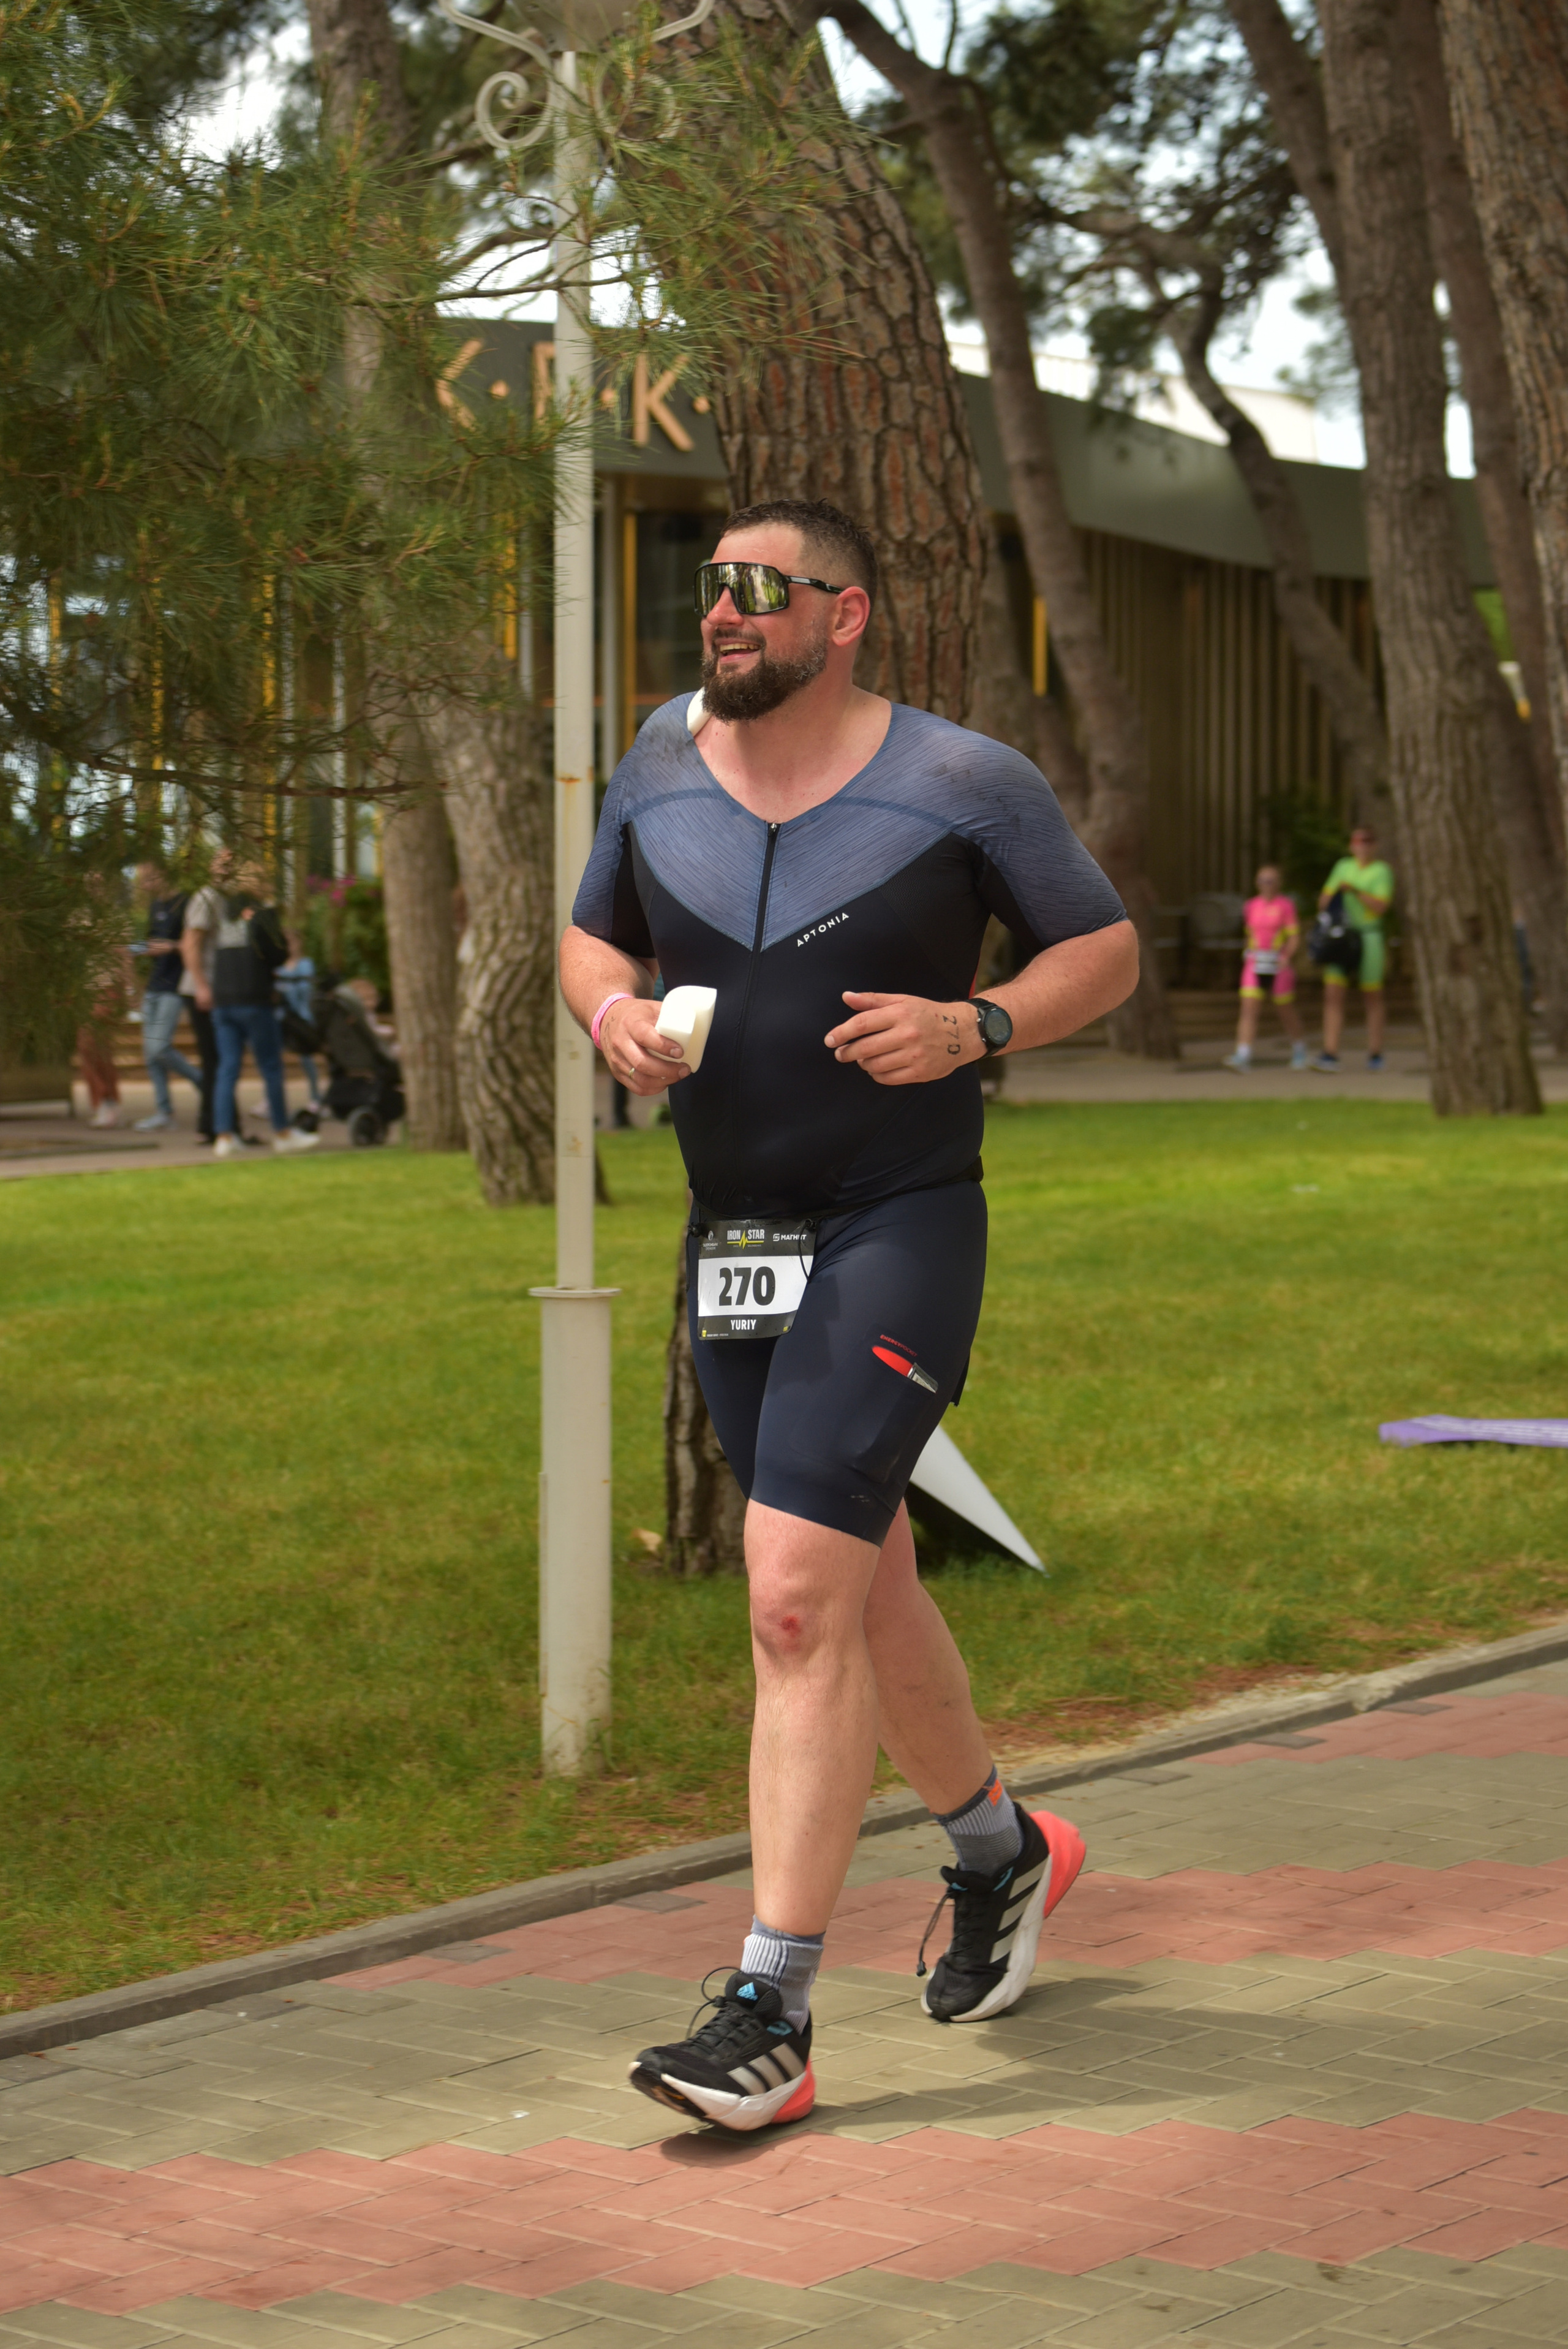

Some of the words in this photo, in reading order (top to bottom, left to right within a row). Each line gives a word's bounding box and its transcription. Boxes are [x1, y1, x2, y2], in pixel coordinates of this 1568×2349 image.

[797, 912, 849, 947] APTONIA
[727, 1230, 741, 1240] IRON
[747, 1229, 764, 1239] STAR
[718, 1266, 775, 1306] 270
[731, 1319, 756, 1330] YURIY
